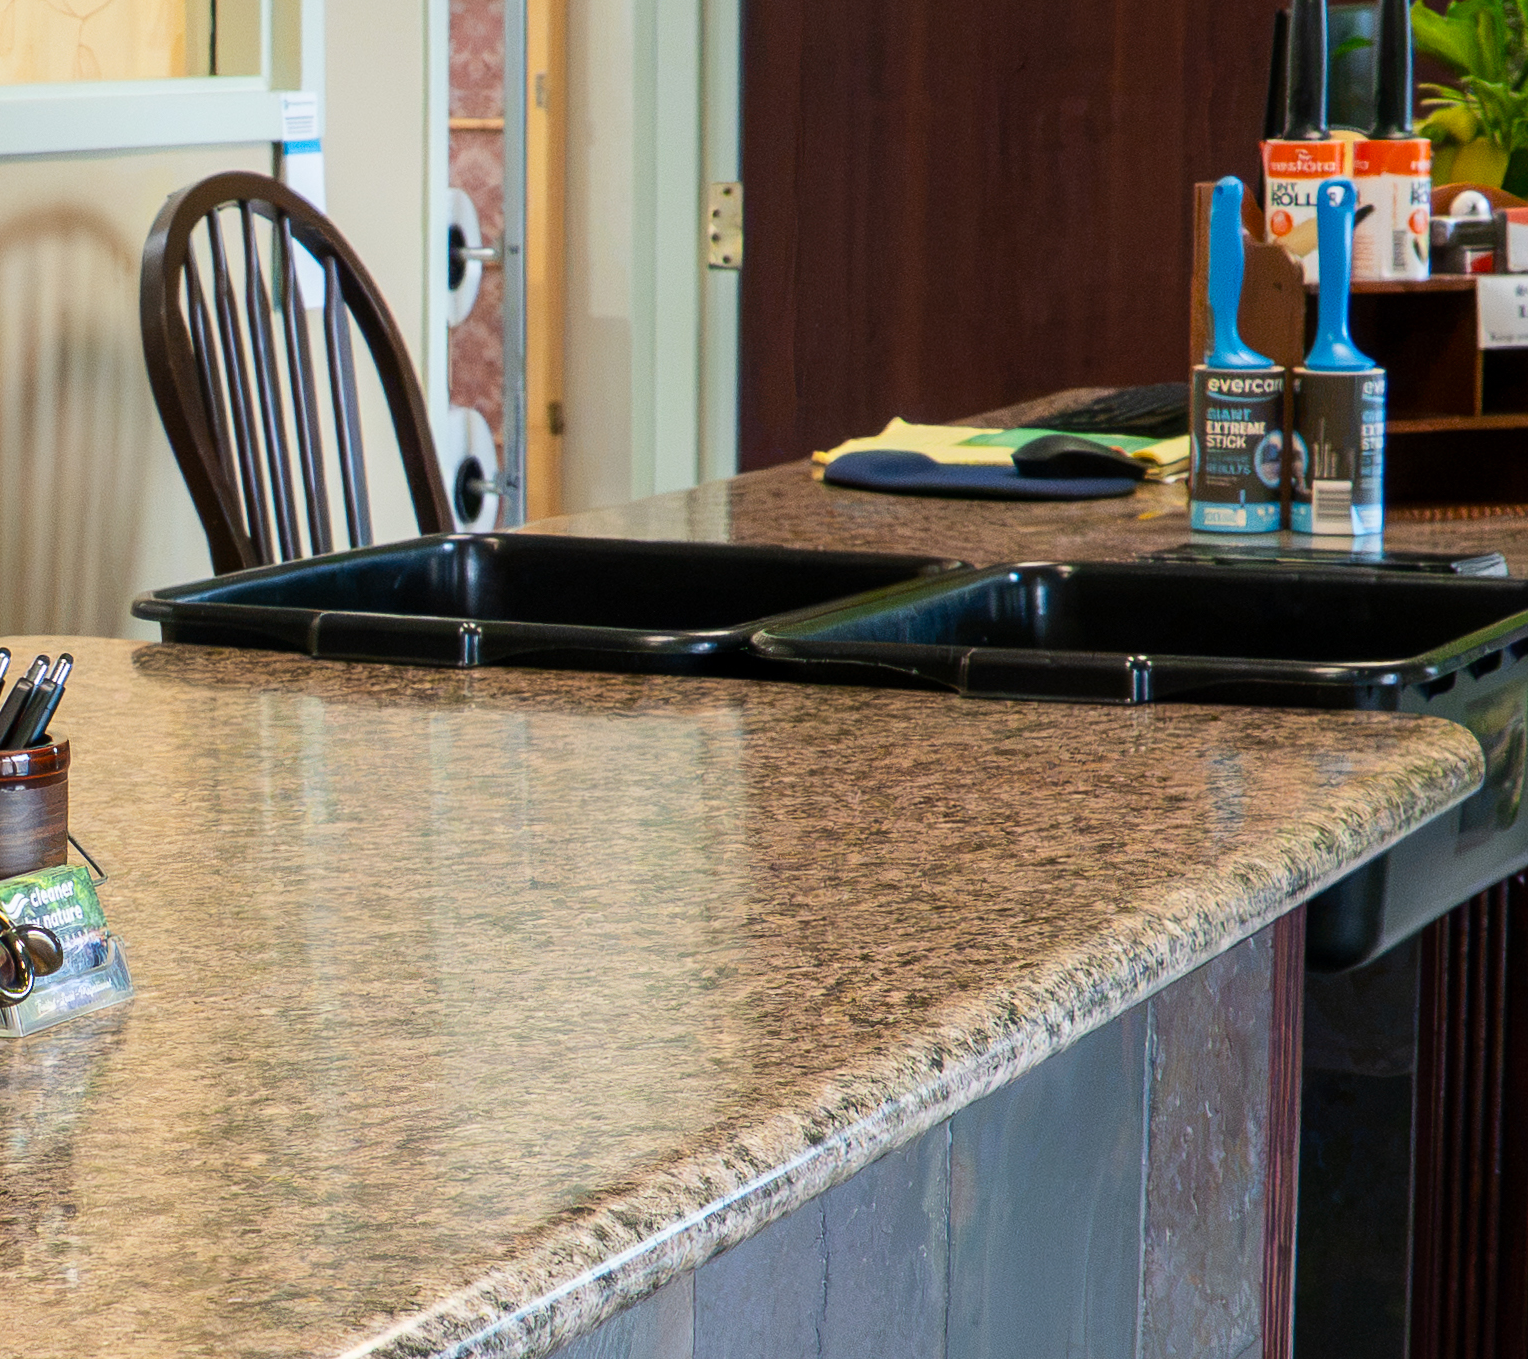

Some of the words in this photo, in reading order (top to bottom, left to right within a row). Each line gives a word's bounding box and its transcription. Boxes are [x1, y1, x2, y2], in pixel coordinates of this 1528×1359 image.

[1206, 421, 1266, 434] EXTREME
[1206, 435, 1247, 448] STICK
[30, 880, 74, 908] cleaner
[43, 904, 83, 929] nature
